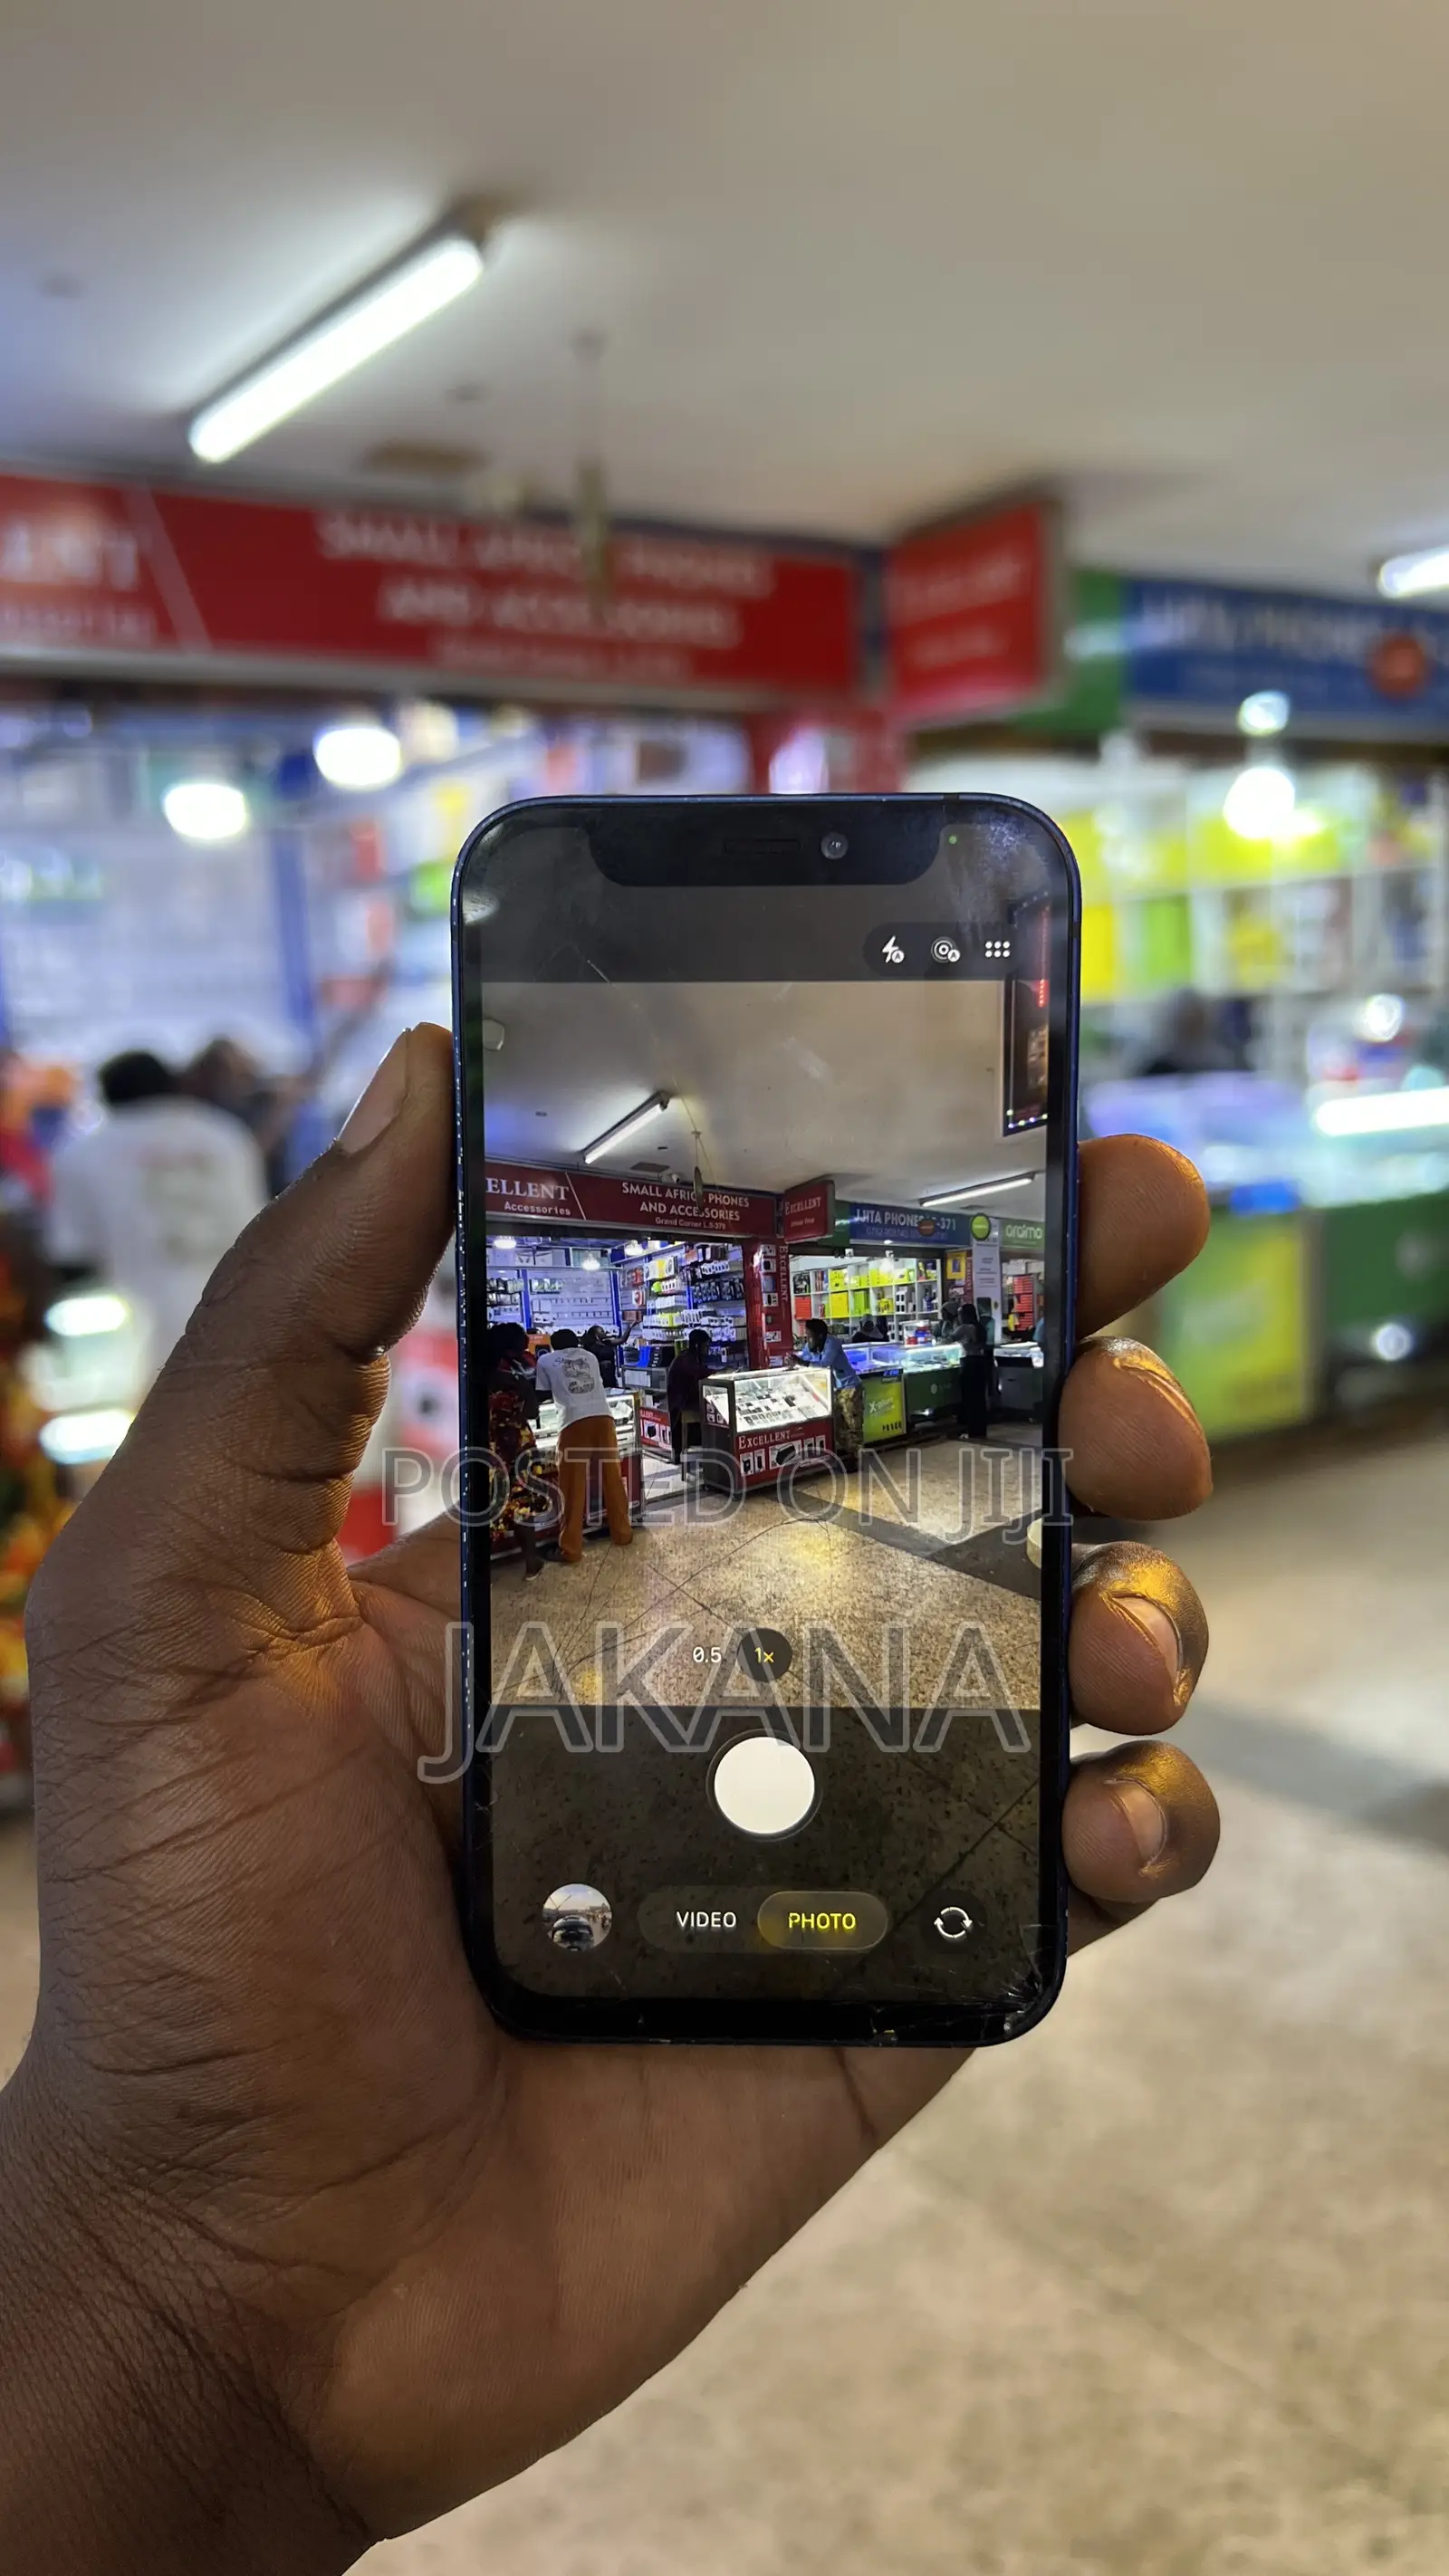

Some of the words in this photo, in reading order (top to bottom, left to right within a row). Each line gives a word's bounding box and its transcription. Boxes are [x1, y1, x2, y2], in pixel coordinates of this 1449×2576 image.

[621, 1182, 662, 1198] SMALL
[665, 1188, 705, 1202] AFRIC
[708, 1192, 750, 1209] PHONES
[504, 1201, 571, 1216] Accessories
[639, 1202, 667, 1214] AND
[692, 1645, 722, 1664] 0.5
[676, 1910, 737, 1929] VIDEO
[787, 1911, 857, 1930] PHOTO
